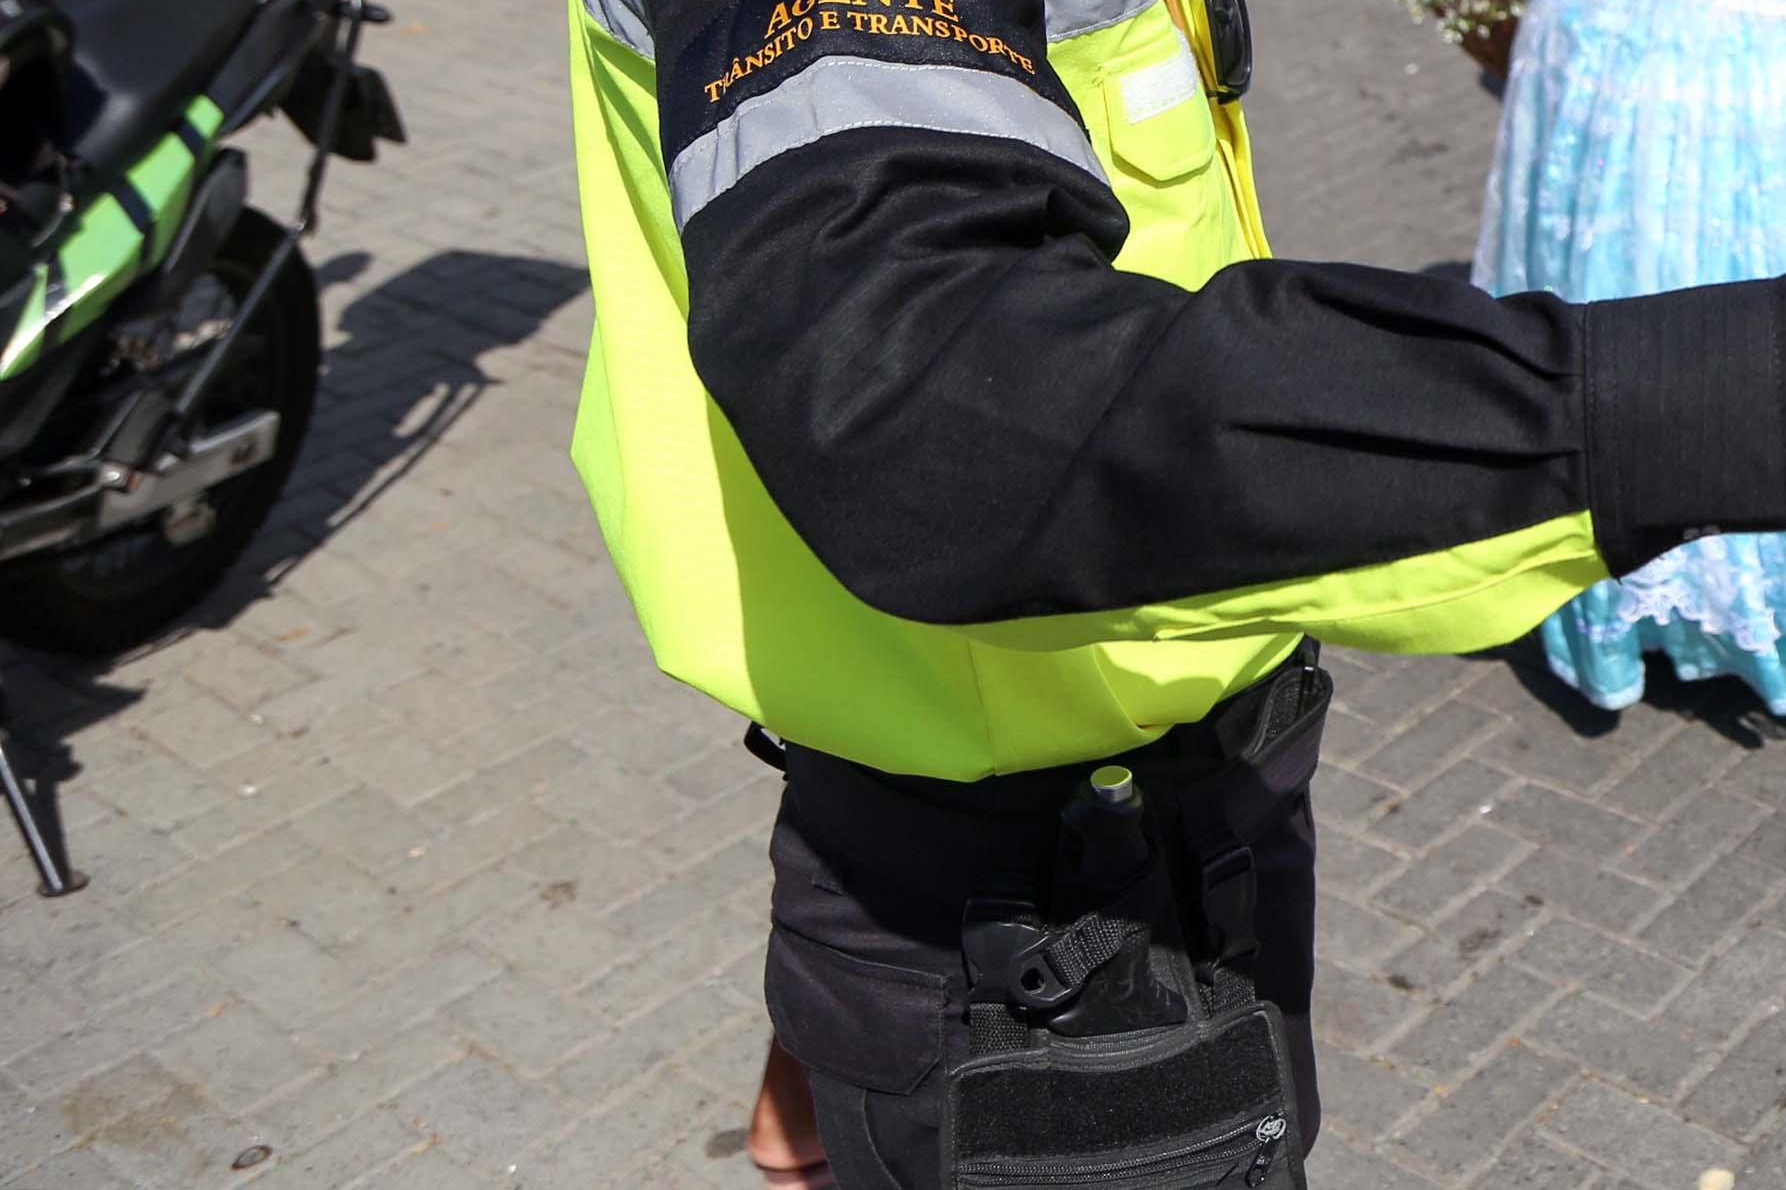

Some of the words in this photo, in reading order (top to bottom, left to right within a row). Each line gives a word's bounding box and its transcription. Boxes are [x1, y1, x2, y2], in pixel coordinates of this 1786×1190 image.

[704, 16, 814, 103] TRÂNSITO
[819, 10, 841, 31] E
[846, 10, 1036, 75] TRANSPORTE
